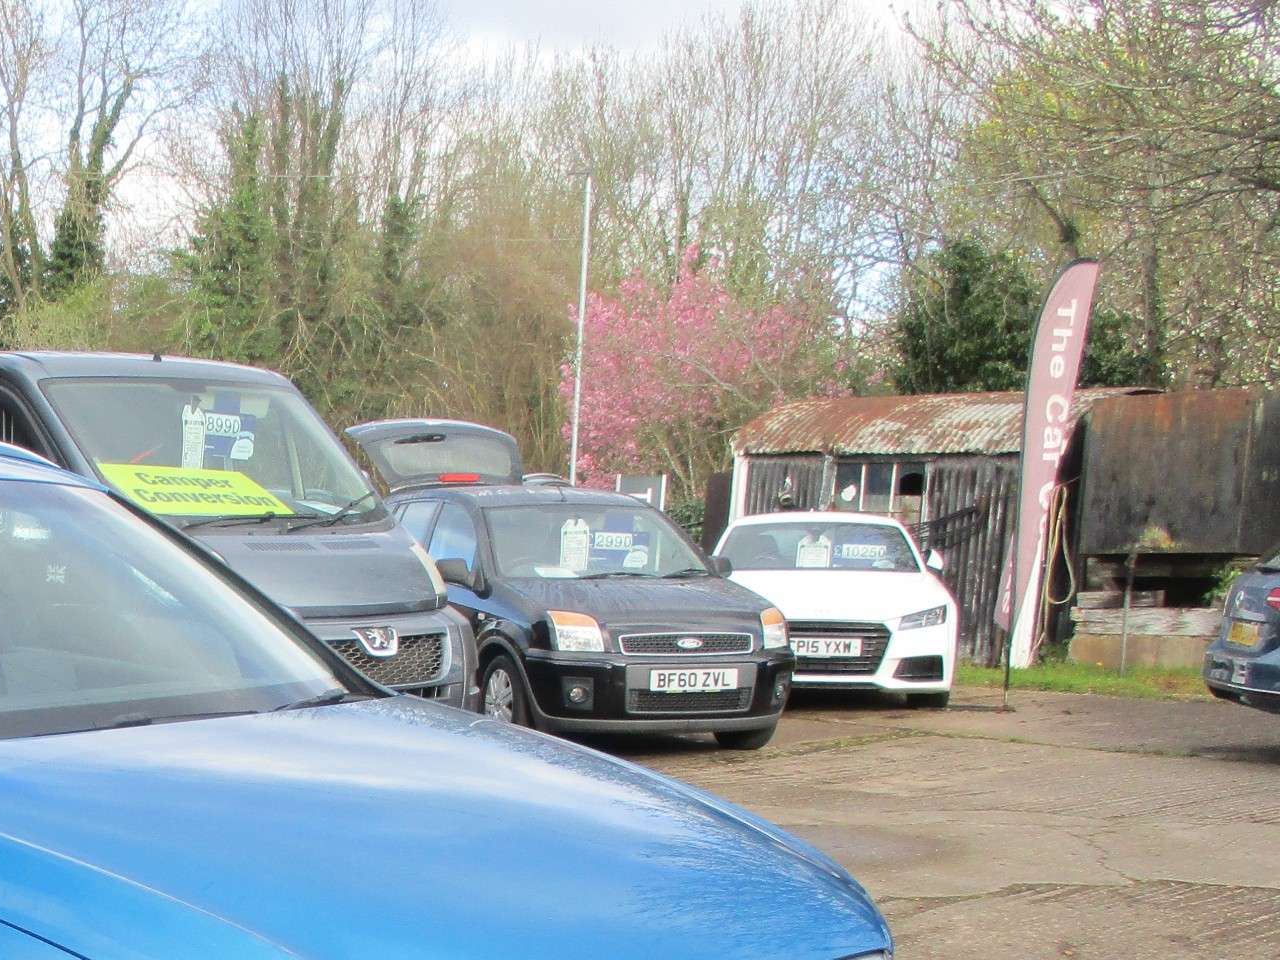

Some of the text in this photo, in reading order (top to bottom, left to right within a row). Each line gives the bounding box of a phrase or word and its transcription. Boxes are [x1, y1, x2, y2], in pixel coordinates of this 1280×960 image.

[1049, 299, 1077, 379] The
[206, 416, 240, 433] 8990
[1042, 394, 1069, 468] Car
[135, 472, 233, 489] Camper
[134, 488, 279, 508] Conversion
[824, 640, 852, 653] YXW
[657, 672, 730, 688] BF60 ZVL
